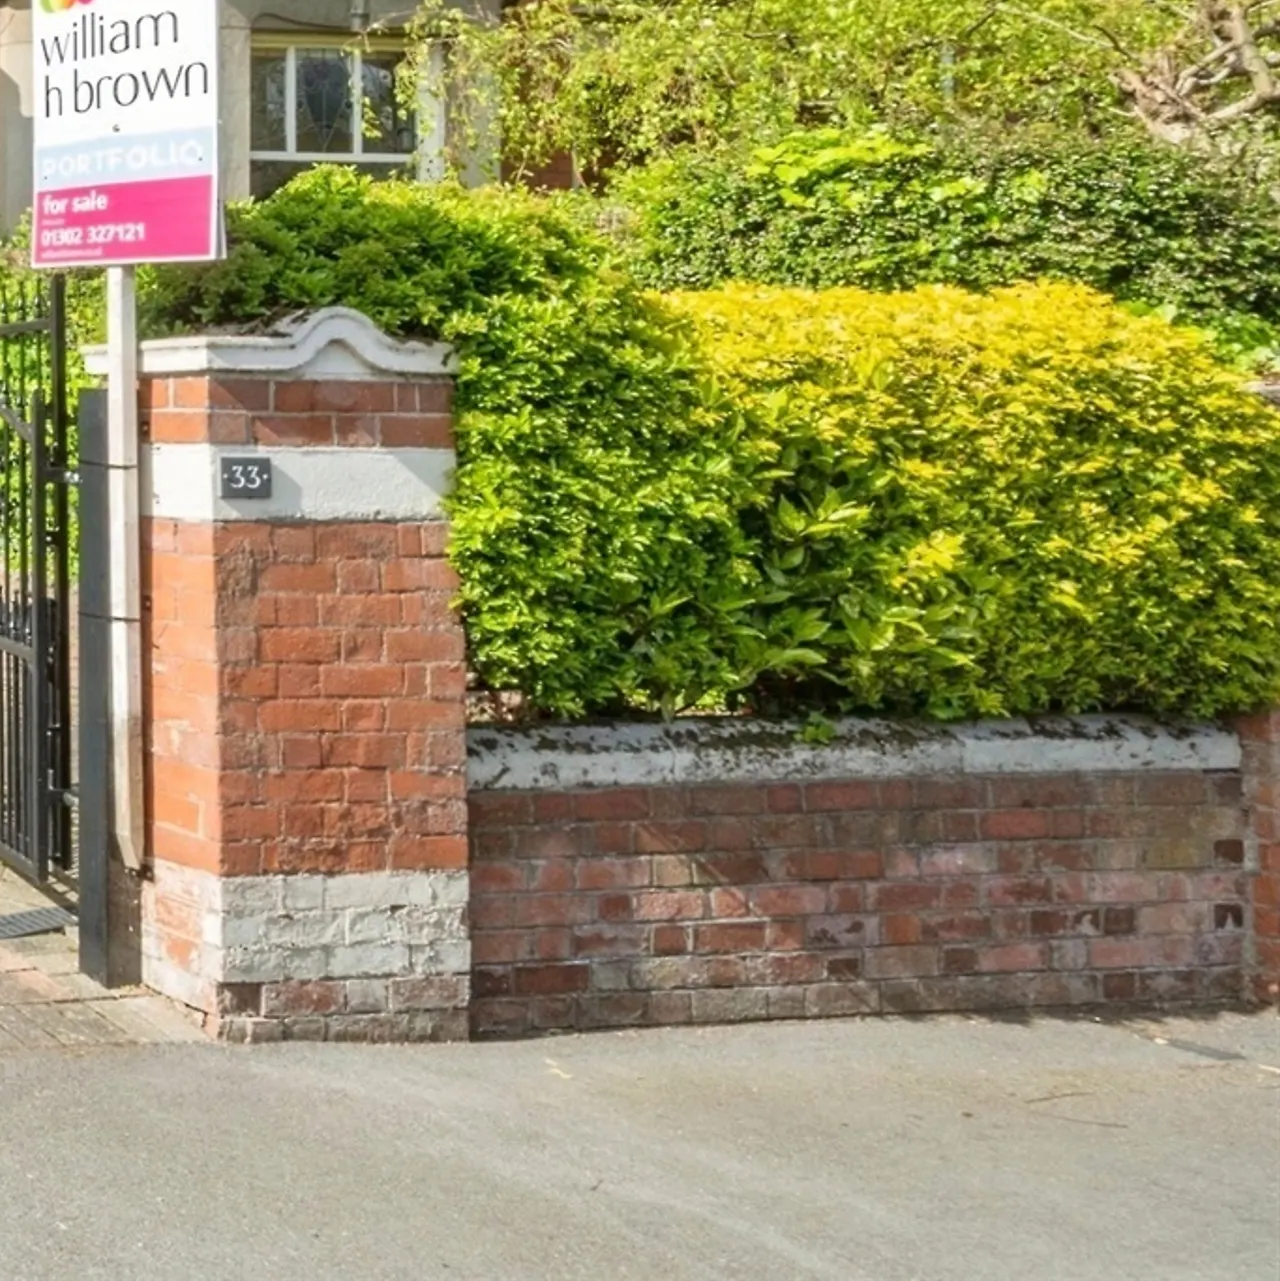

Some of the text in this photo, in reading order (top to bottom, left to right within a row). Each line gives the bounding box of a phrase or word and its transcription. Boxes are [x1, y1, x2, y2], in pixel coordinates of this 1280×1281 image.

[41, 11, 178, 66] william
[44, 61, 208, 118] h brown
[41, 139, 204, 177] PORTFOLIO
[43, 190, 108, 214] for sale
[41, 223, 146, 246] 01302 327121
[230, 465, 261, 488] 33
